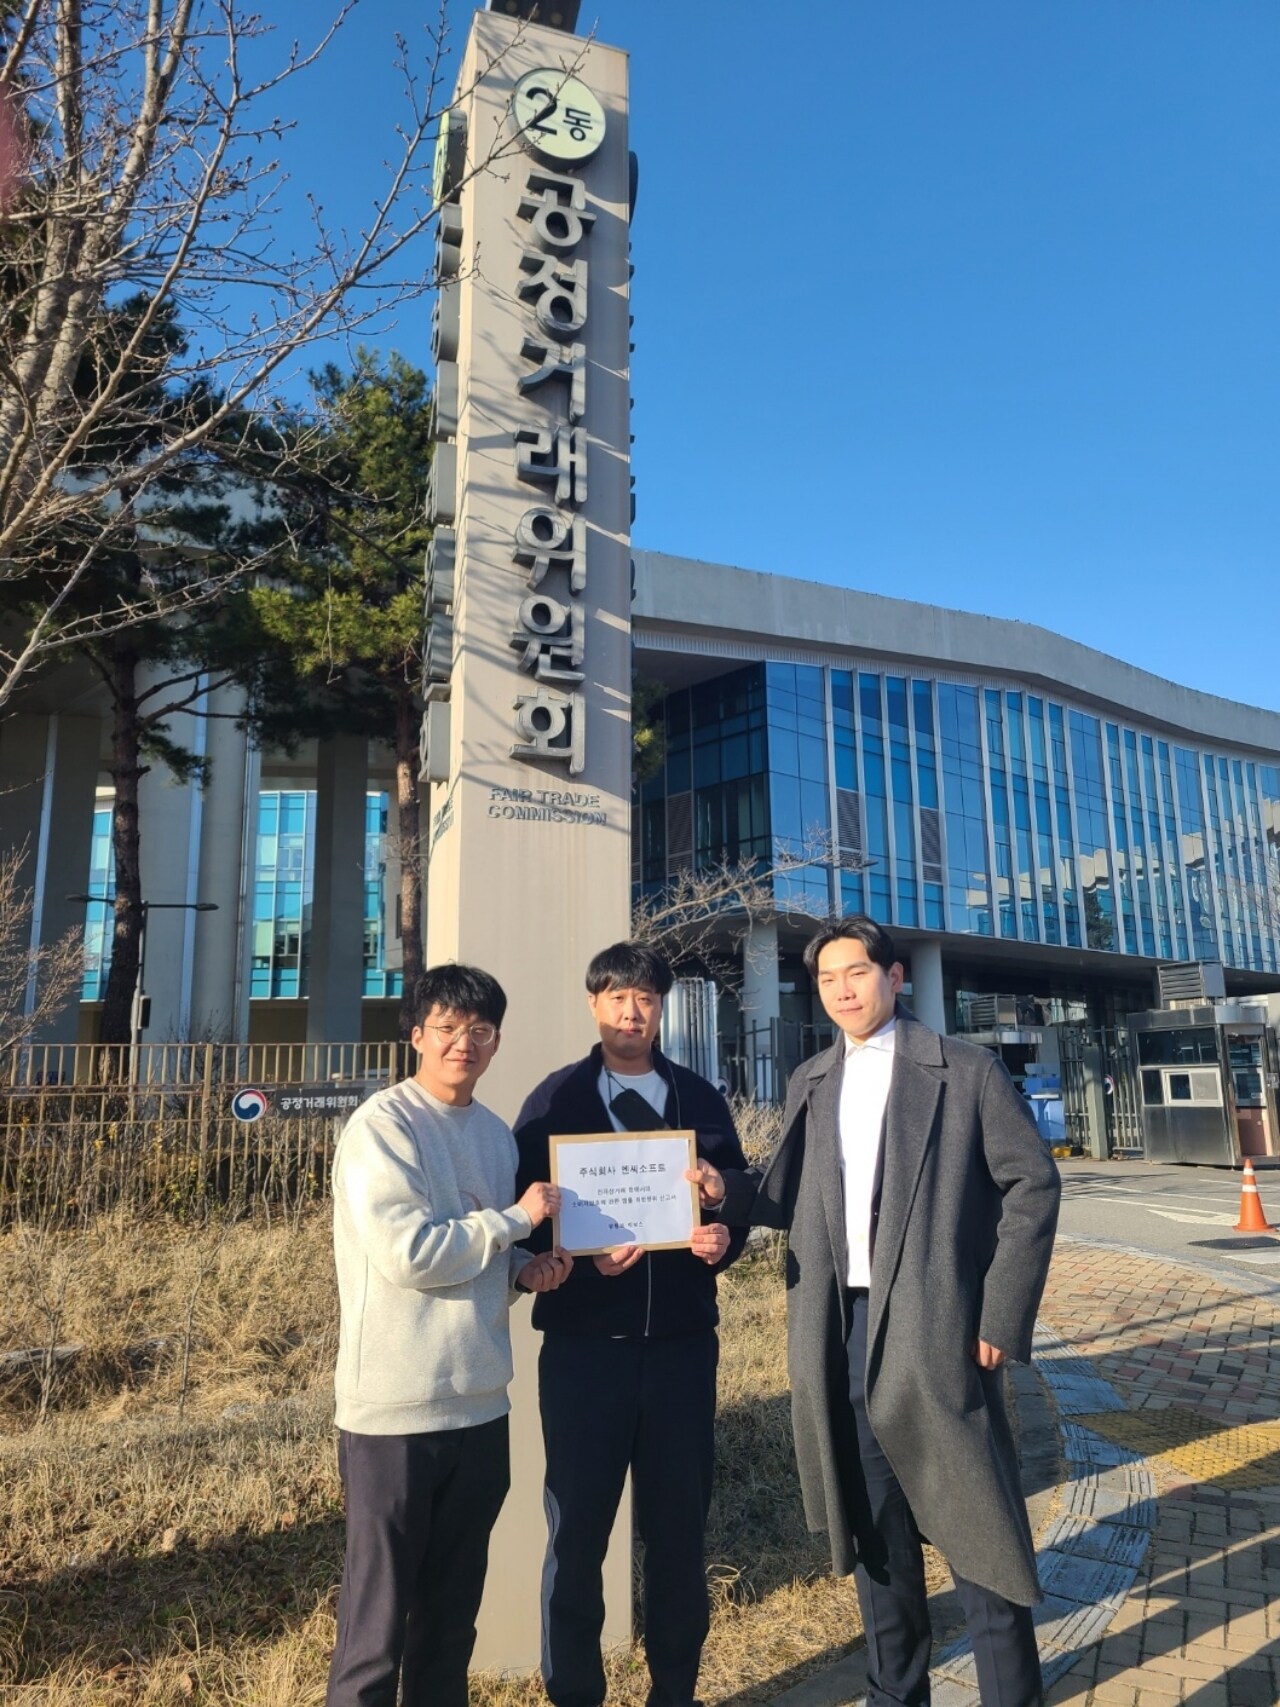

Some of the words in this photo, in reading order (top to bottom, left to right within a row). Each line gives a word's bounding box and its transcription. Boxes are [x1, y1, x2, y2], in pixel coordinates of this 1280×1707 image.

[525, 86, 593, 142] 2동
[509, 168, 597, 775] 공정거래위원회
[489, 787, 533, 803] FAIR
[537, 790, 601, 808] TRADE
[488, 805, 607, 826] COMMISSION
[280, 1095, 359, 1111] 공정거래위원회
[579, 1165, 616, 1178] 주식회사
[621, 1163, 666, 1175] 엔씨소프트
